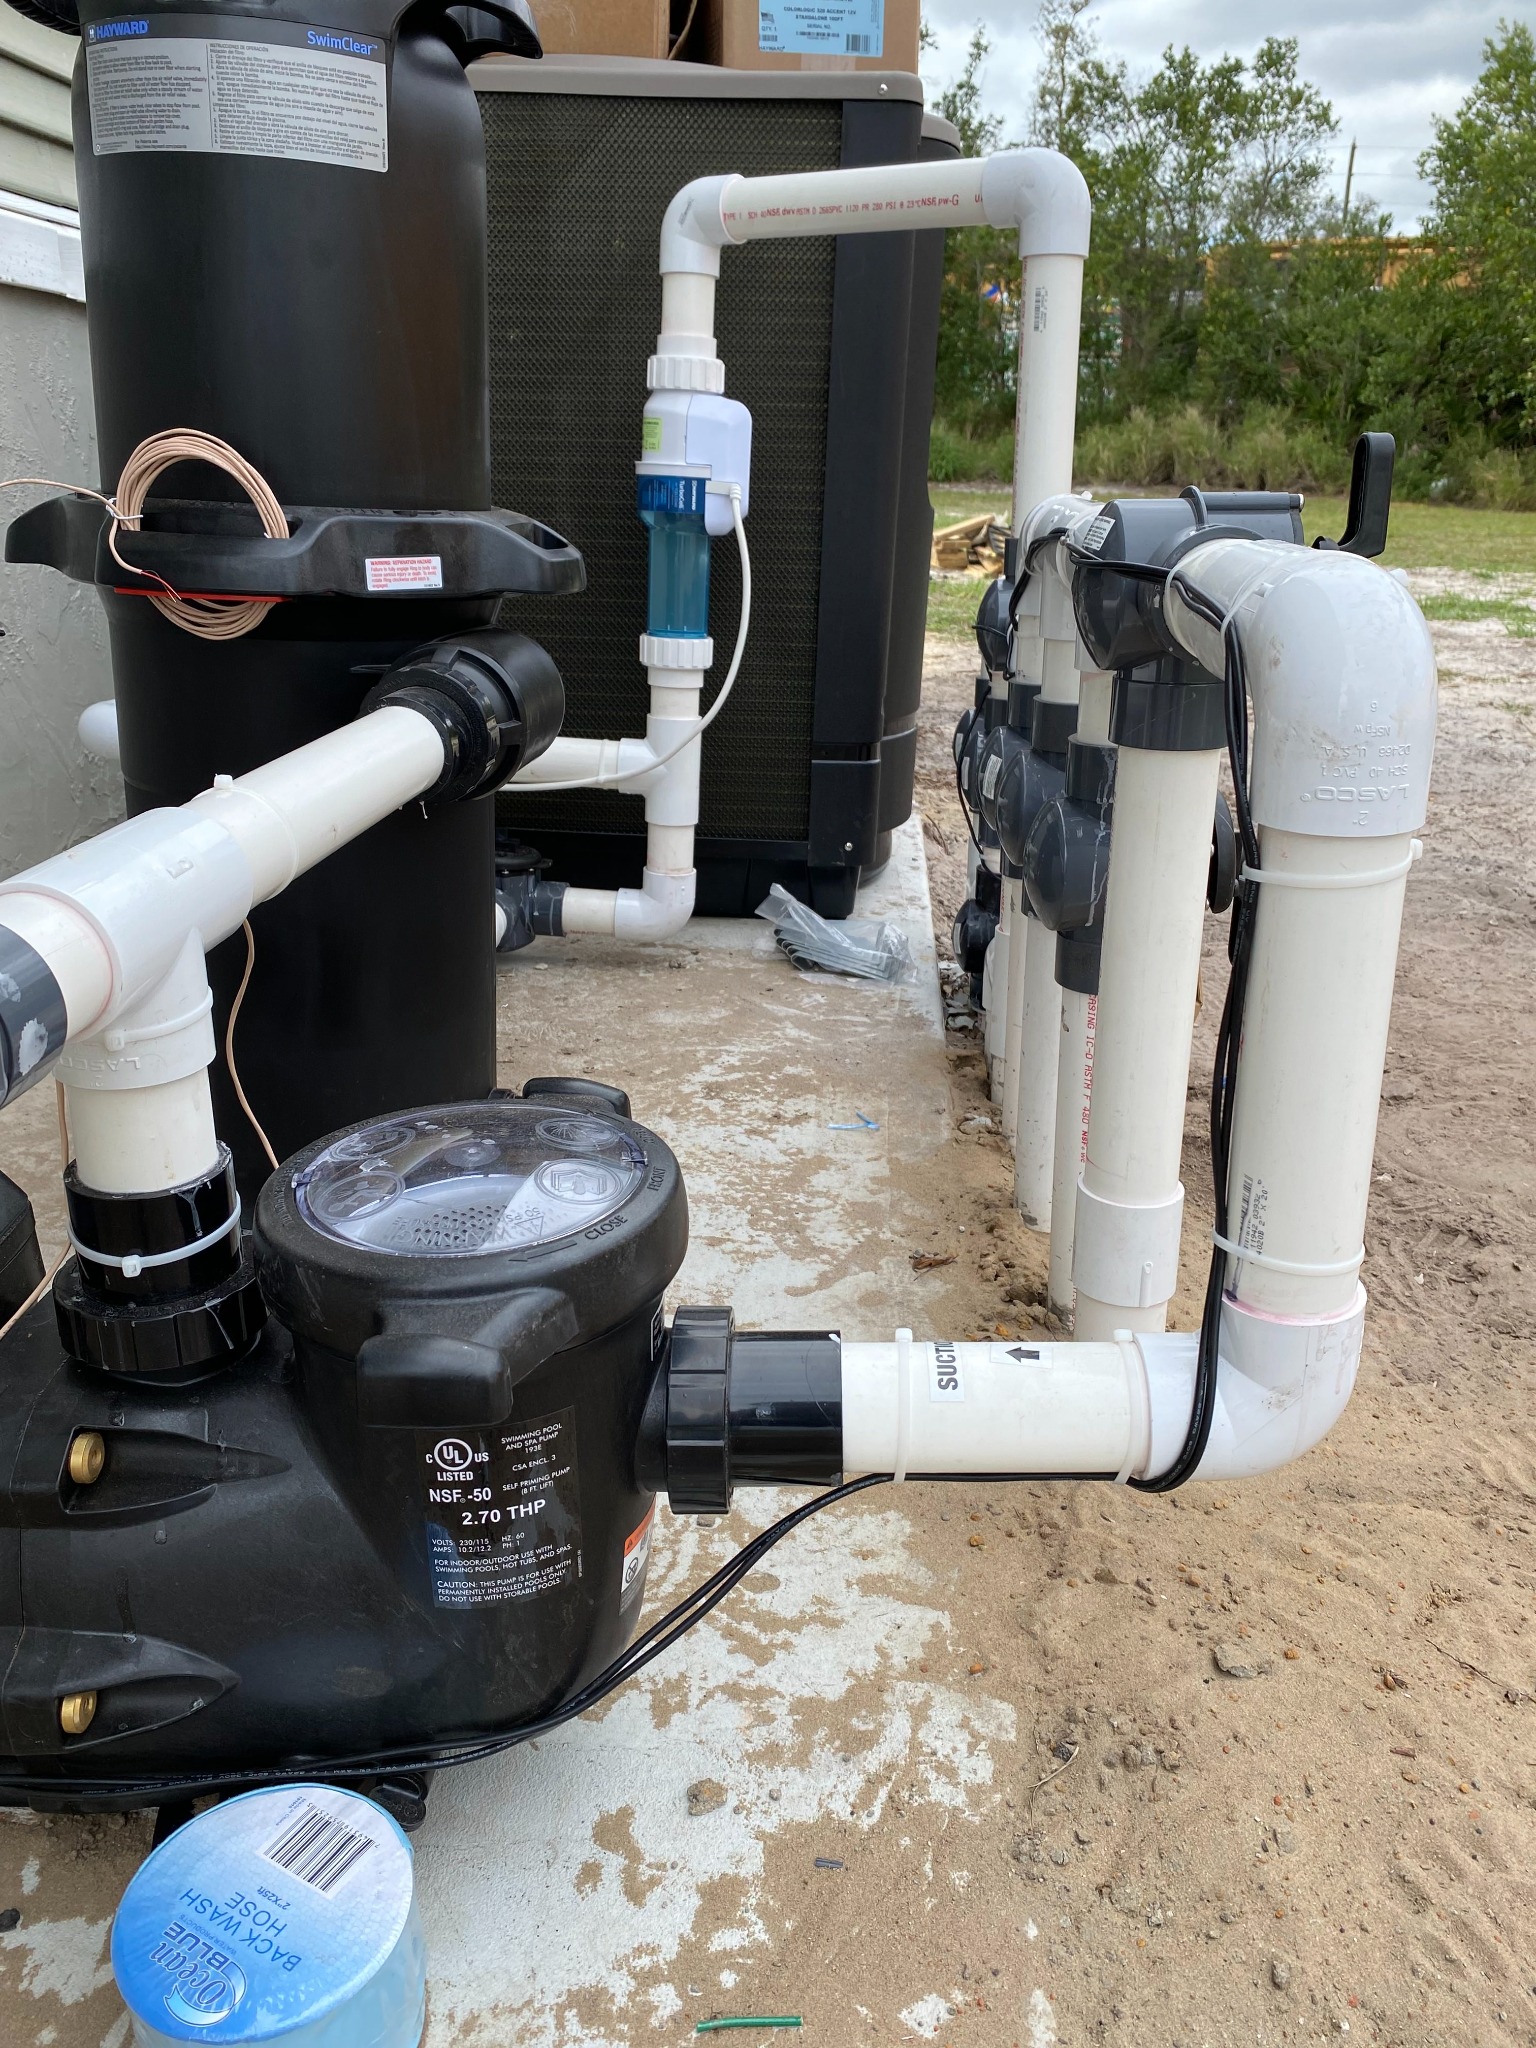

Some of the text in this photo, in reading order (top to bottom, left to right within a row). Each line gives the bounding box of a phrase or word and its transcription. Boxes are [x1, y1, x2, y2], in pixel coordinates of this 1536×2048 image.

[96, 20, 148, 39] HAYWARD
[1083, 1065, 1093, 1090] ASTM
[1081, 1106, 1090, 1125] 480
[585, 1214, 629, 1241] CLOSE
[501, 1422, 563, 1444] SWIMMING POOL
[505, 1431, 559, 1451] AND SPA PUMP
[425, 1445, 490, 1464] C UL US
[525, 1444, 542, 1454] 193E
[512, 1463, 528, 1472] CSA
[528, 1457, 550, 1469] ENCL.
[436, 1471, 474, 1481] LISTED
[502, 1466, 571, 1492] SELF PRIMING PUMP
[521, 1487, 528, 1496] (8
[539, 1480, 554, 1491] LIFT)
[461, 1499, 546, 1526] 2.70 THP
[431, 1538, 490, 1547] VOLTS: 230/115
[501, 1532, 525, 1543] HZ: 60
[502, 1541, 515, 1549] PH:
[435, 1566, 474, 1574] SWIMMING
[502, 1562, 518, 1570] HOT
[519, 1556, 539, 1567] TUBS,
[539, 1550, 555, 1561] AND
[556, 1543, 573, 1555] SPAS.
[450, 1553, 520, 1567] INDOOR/OUTDOOR
[520, 1550, 535, 1559] USE
[535, 1544, 553, 1556] WITH
[458, 1545, 492, 1553] 10.2/12.2
[437, 1558, 572, 1589] CAUTION: THIS PUMP IS FOR USE WITH
[437, 1588, 487, 1596] PERMANENTLY
[487, 1583, 523, 1594] INSTALLED
[524, 1576, 548, 1590] POOLS
[451, 1595, 468, 1603] NOT
[468, 1595, 483, 1603] USE
[483, 1593, 502, 1601] WITH
[503, 1587, 537, 1599] STORABLE
[538, 1578, 562, 1590] POOLS.
[225, 1890, 288, 1937] HOSE
[179, 1888, 302, 1972] BACK WASH
[163, 1921, 231, 1971] BLUE
[150, 1942, 227, 2007] Ocean
